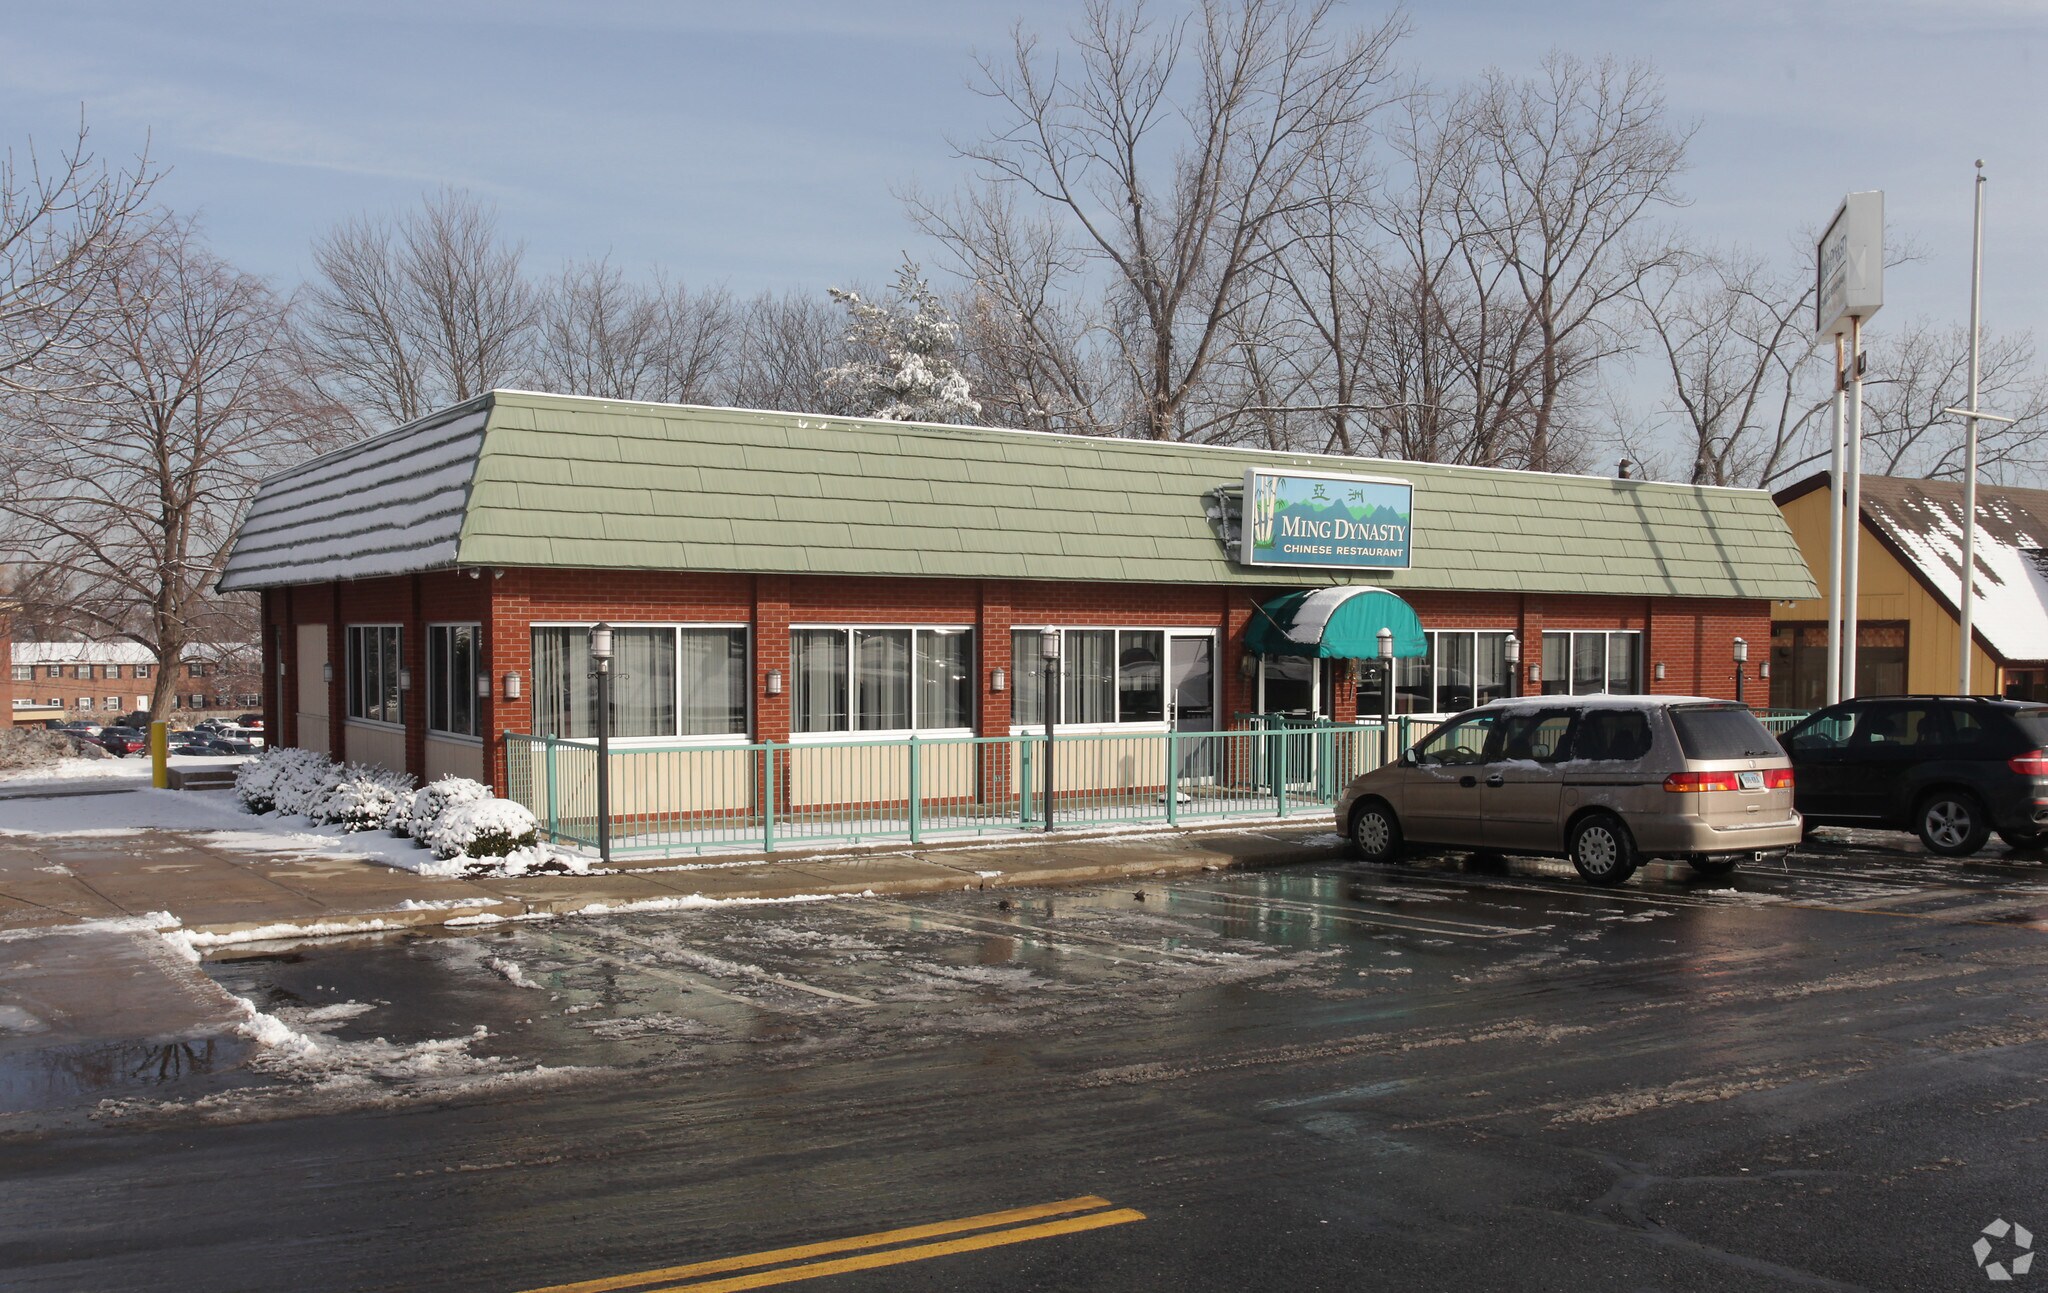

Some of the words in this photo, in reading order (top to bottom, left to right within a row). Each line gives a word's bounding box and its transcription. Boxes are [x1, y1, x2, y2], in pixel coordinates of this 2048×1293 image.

[1281, 515, 1331, 539] MING
[1334, 518, 1406, 542] DYNASTY
[1283, 544, 1332, 555] CHINESE
[1336, 546, 1404, 557] RESTAURANT
